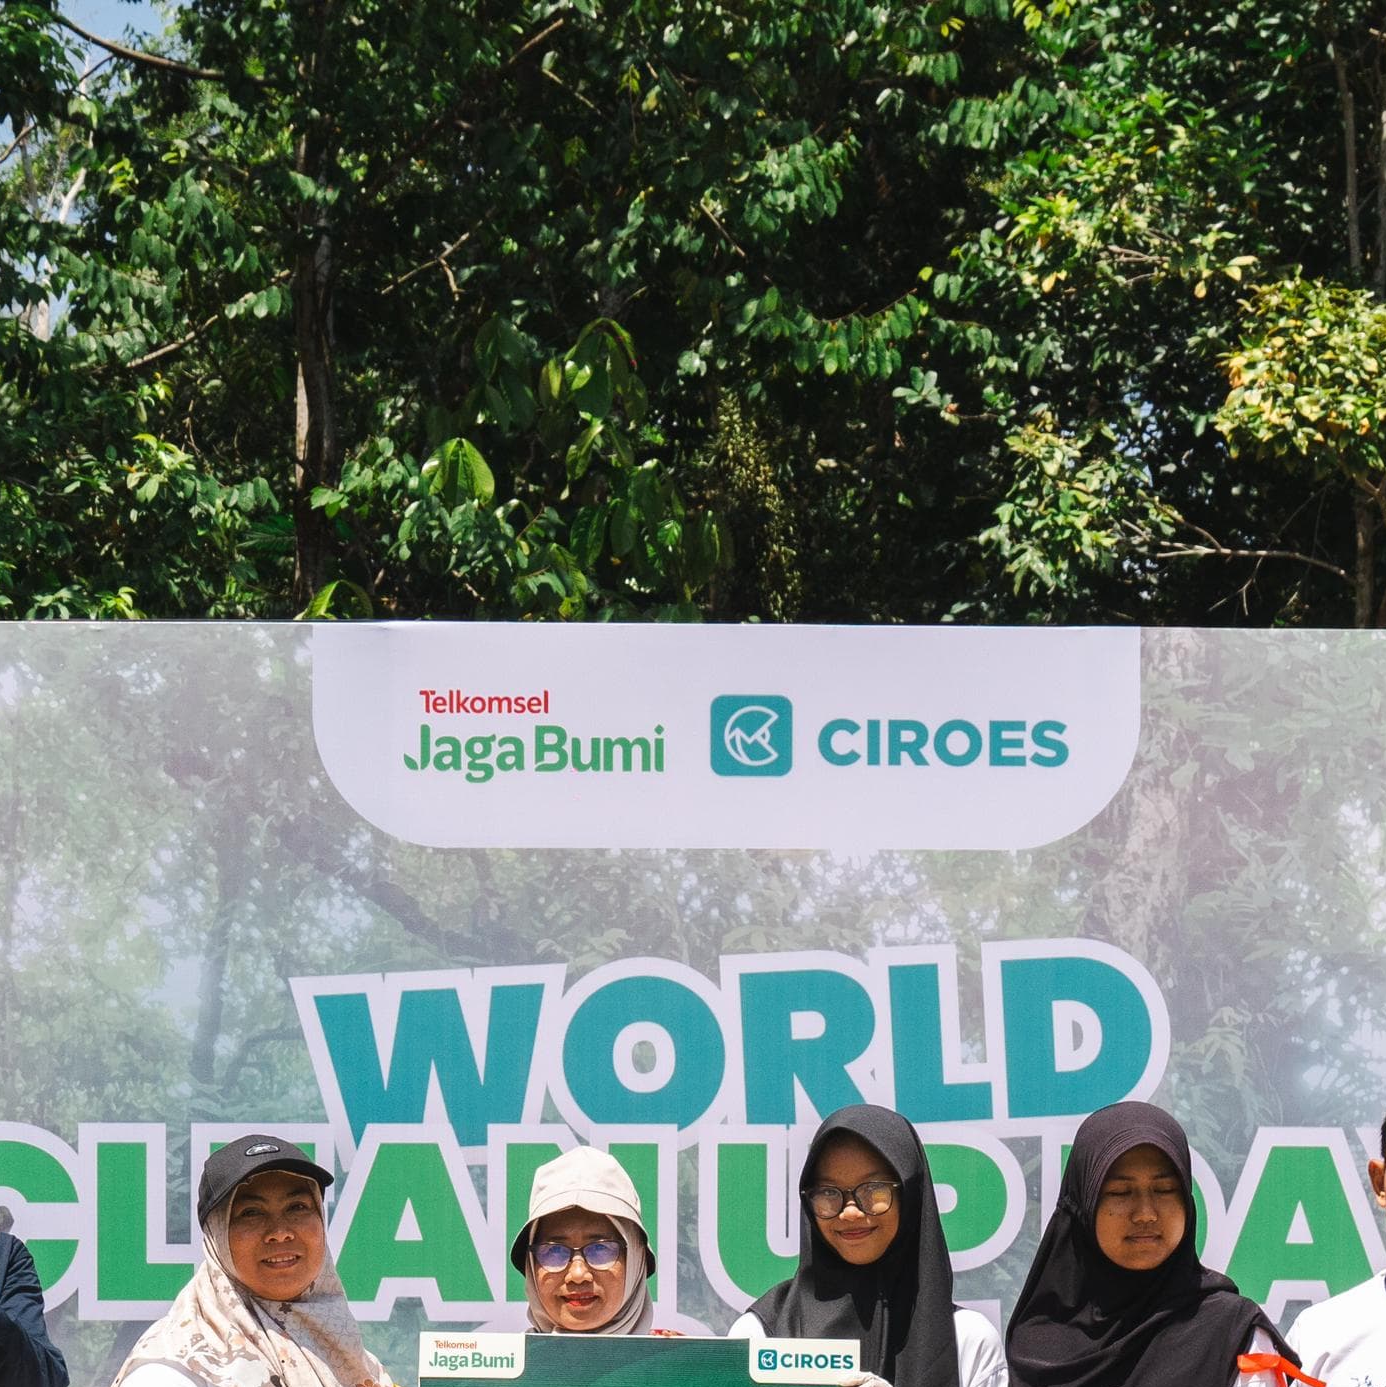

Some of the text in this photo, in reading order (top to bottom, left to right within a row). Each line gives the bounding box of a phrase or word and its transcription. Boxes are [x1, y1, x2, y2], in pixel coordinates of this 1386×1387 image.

[419, 689, 549, 715] Telkomsel
[404, 723, 665, 784] Jaga Bumi
[817, 718, 1070, 768] CIROES
[305, 952, 1158, 1146] WORLD
[434, 1339, 477, 1350] Telkomsel
[429, 1351, 515, 1371] Jaga Bumi
[780, 1353, 854, 1370] CIROES
